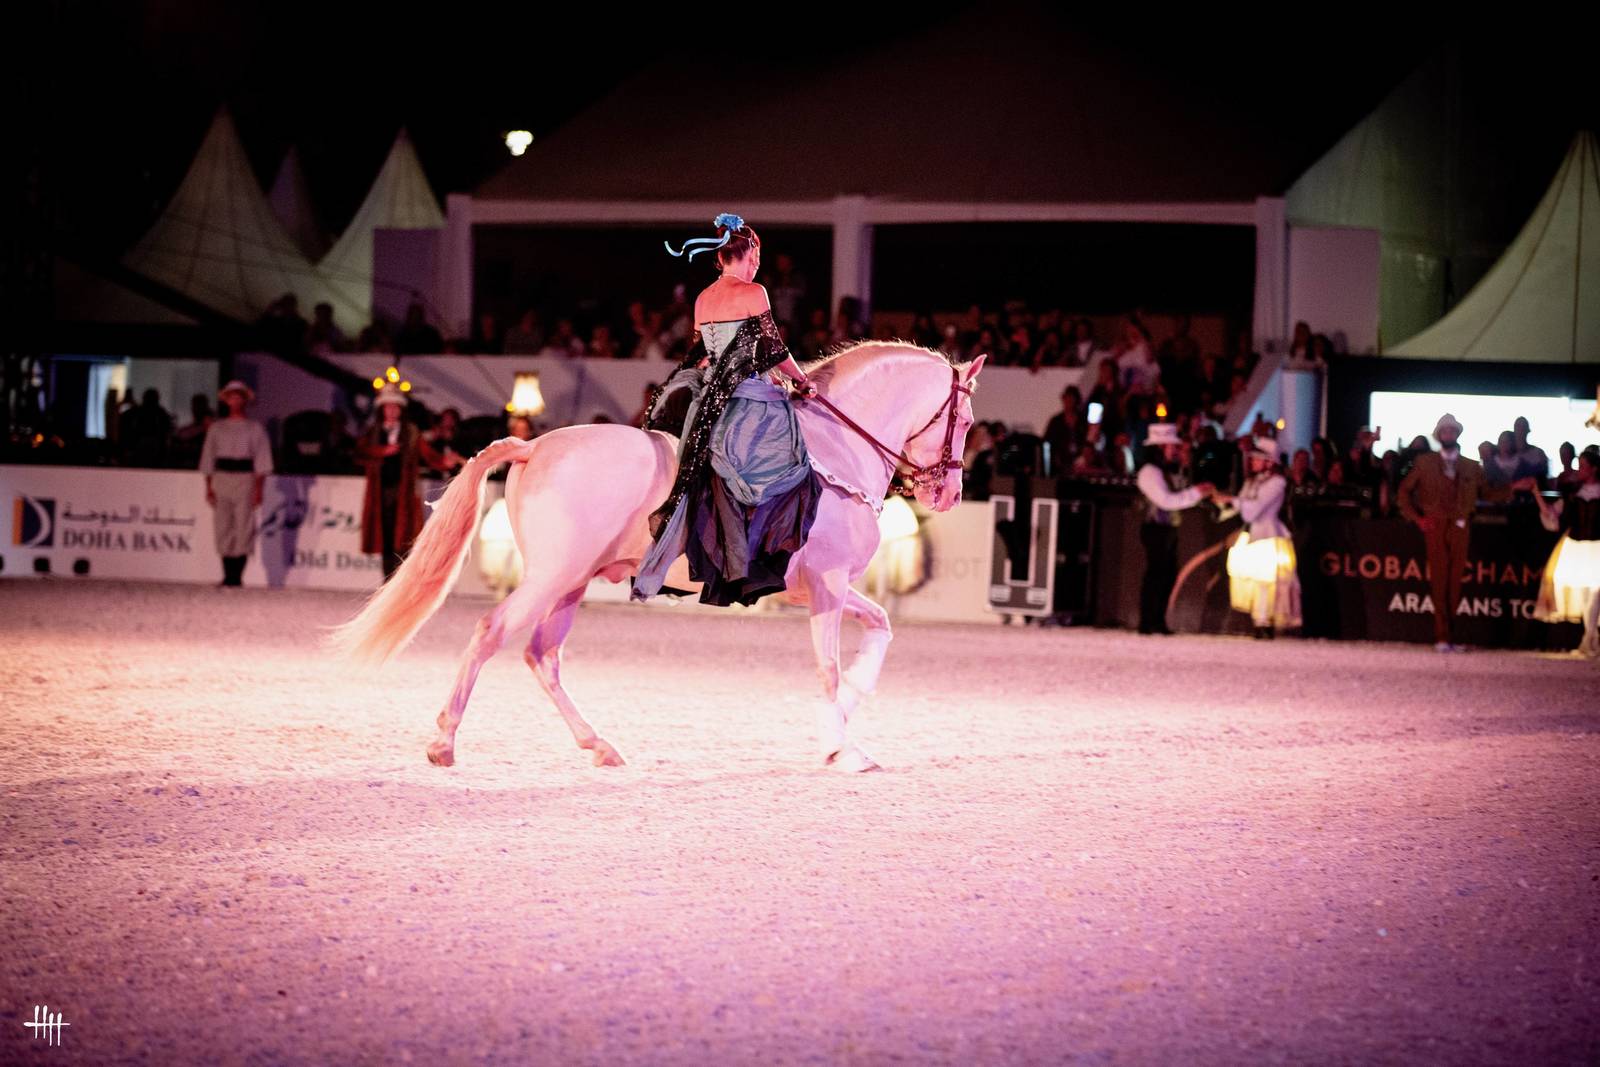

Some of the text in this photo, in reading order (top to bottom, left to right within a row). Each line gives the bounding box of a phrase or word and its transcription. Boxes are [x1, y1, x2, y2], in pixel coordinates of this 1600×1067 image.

[63, 529, 192, 552] DOHA BANK
[1460, 560, 1545, 586] CHAM
[1388, 593, 1537, 619] ARAANS TO
